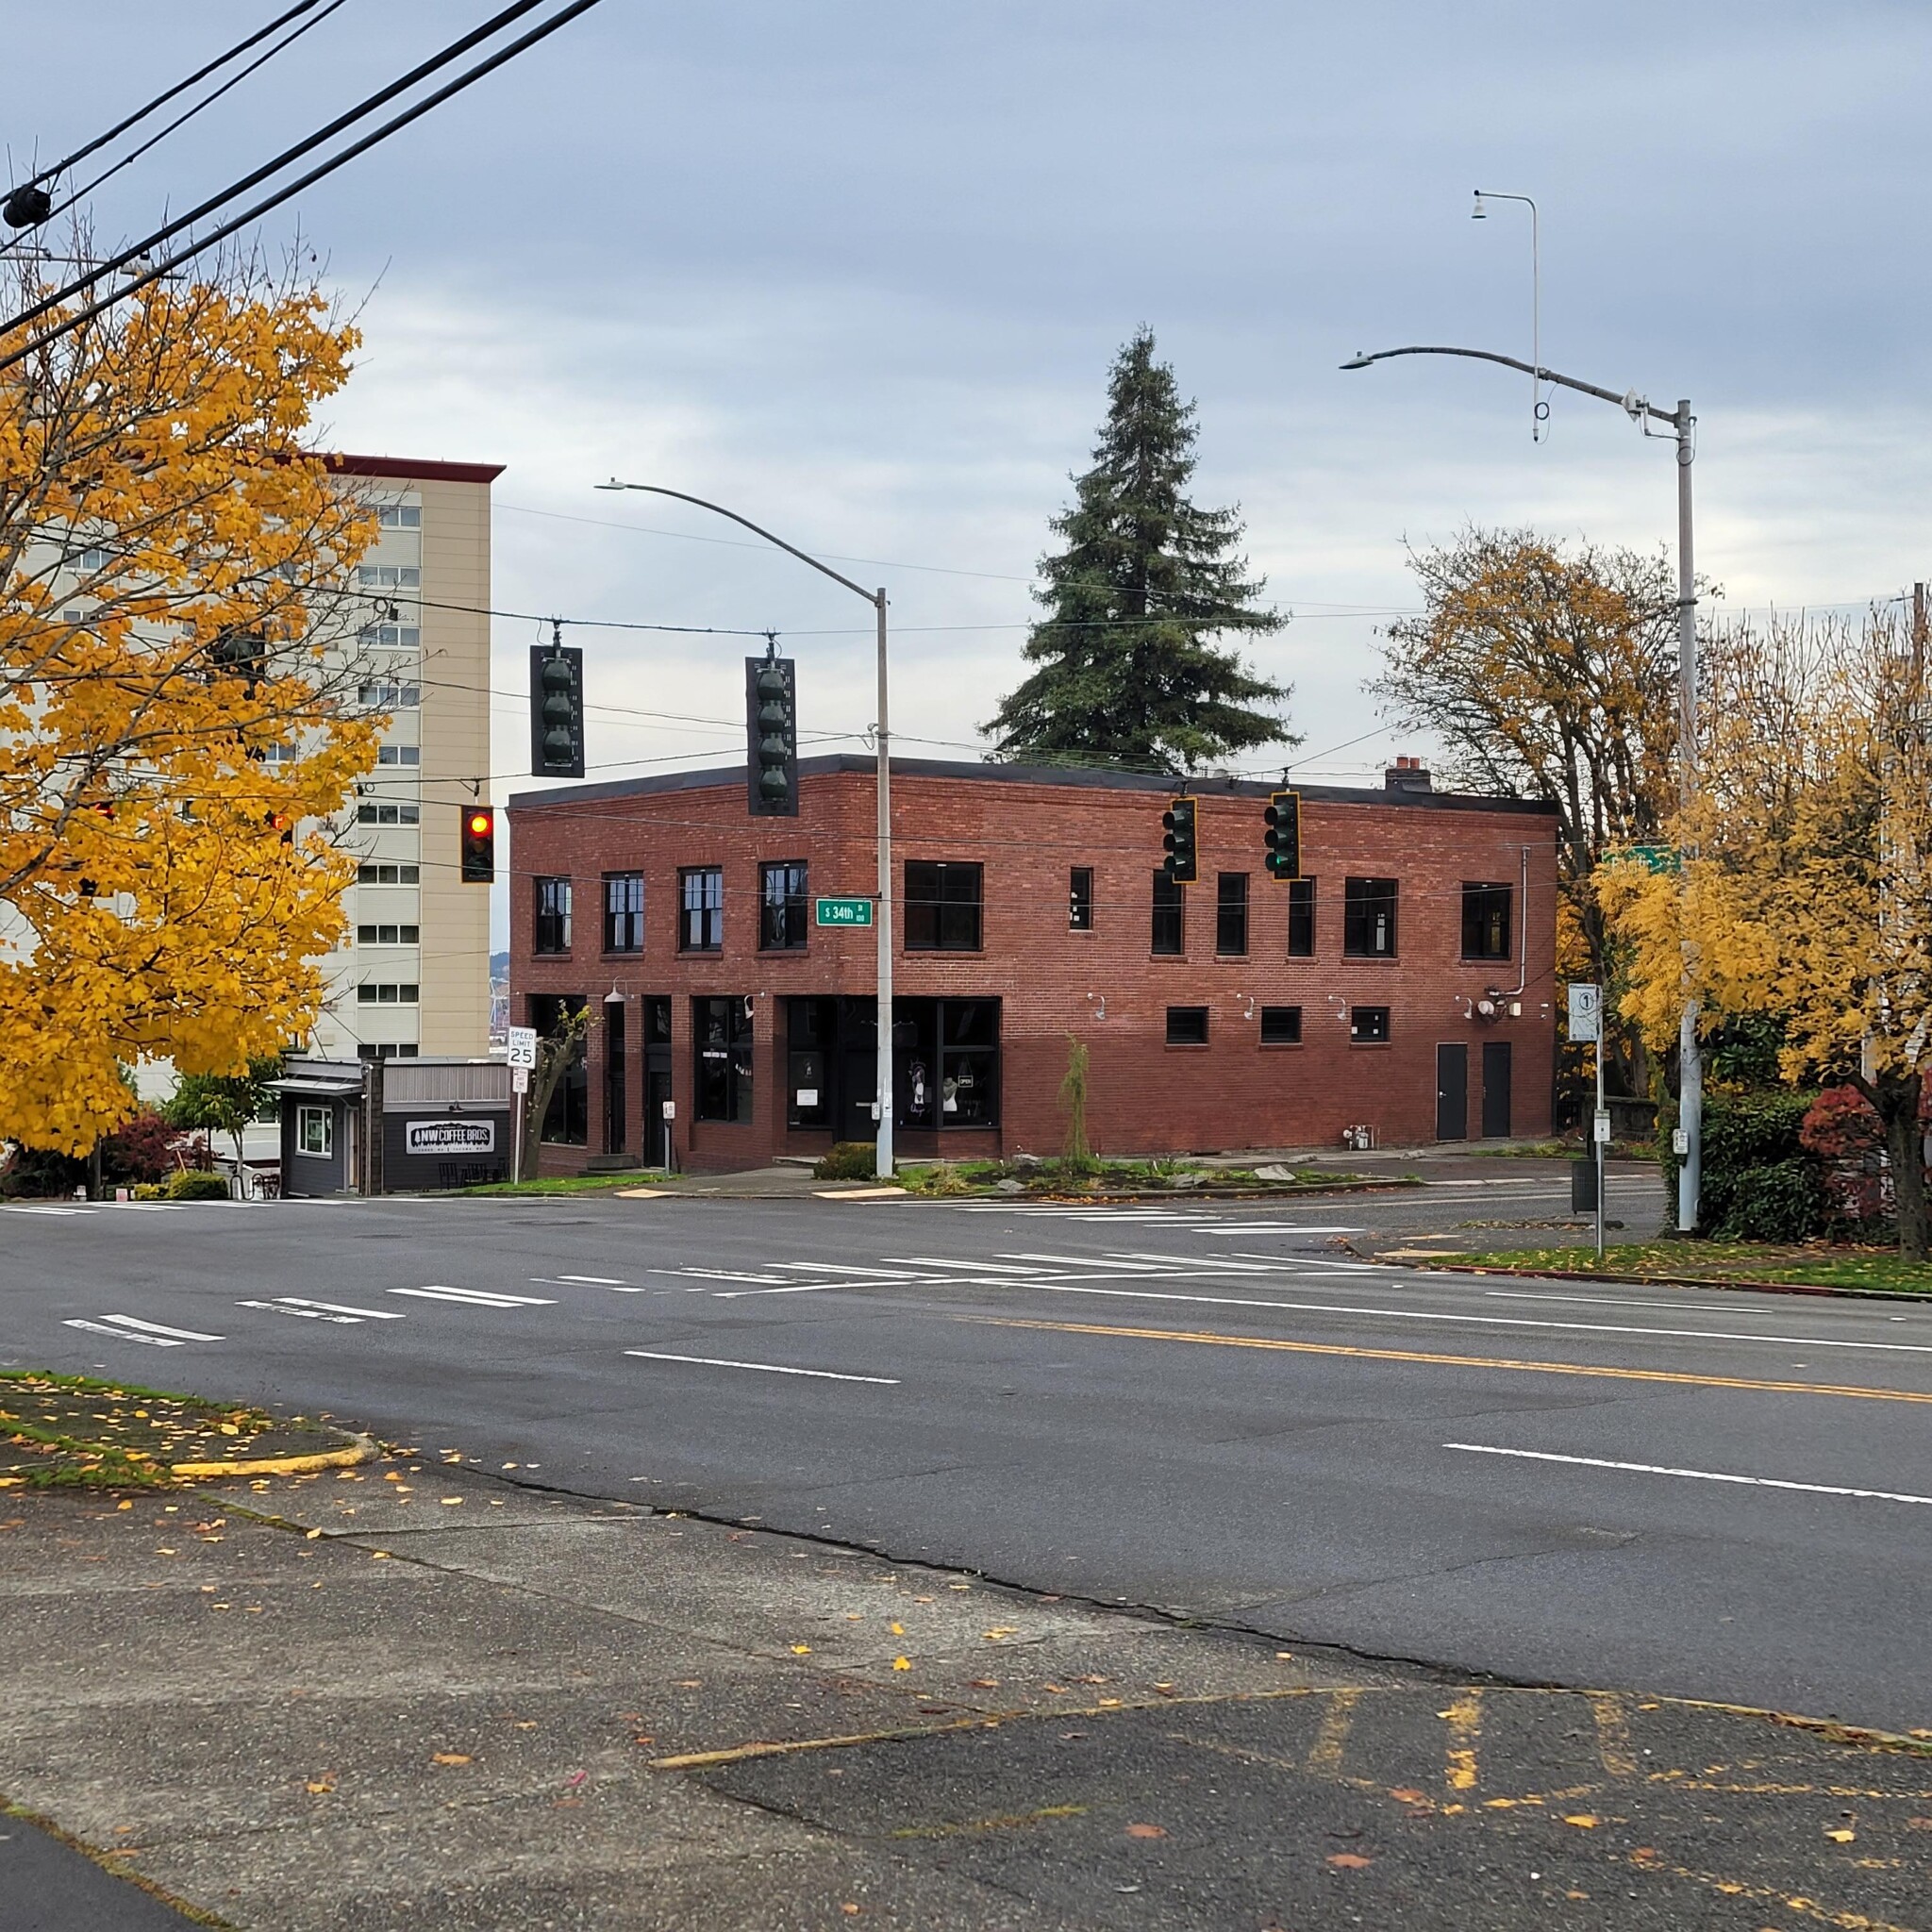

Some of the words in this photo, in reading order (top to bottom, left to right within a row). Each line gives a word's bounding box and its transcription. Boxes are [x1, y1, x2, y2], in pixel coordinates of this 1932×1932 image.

[825, 908, 830, 917] S
[833, 906, 853, 919] 34th
[1584, 995, 1589, 1008] 1
[510, 1031, 533, 1040] SPEED
[511, 1048, 532, 1063] 25
[422, 1130, 438, 1141] NW
[439, 1129, 465, 1141] COFFEE
[467, 1129, 489, 1141] BROS.
